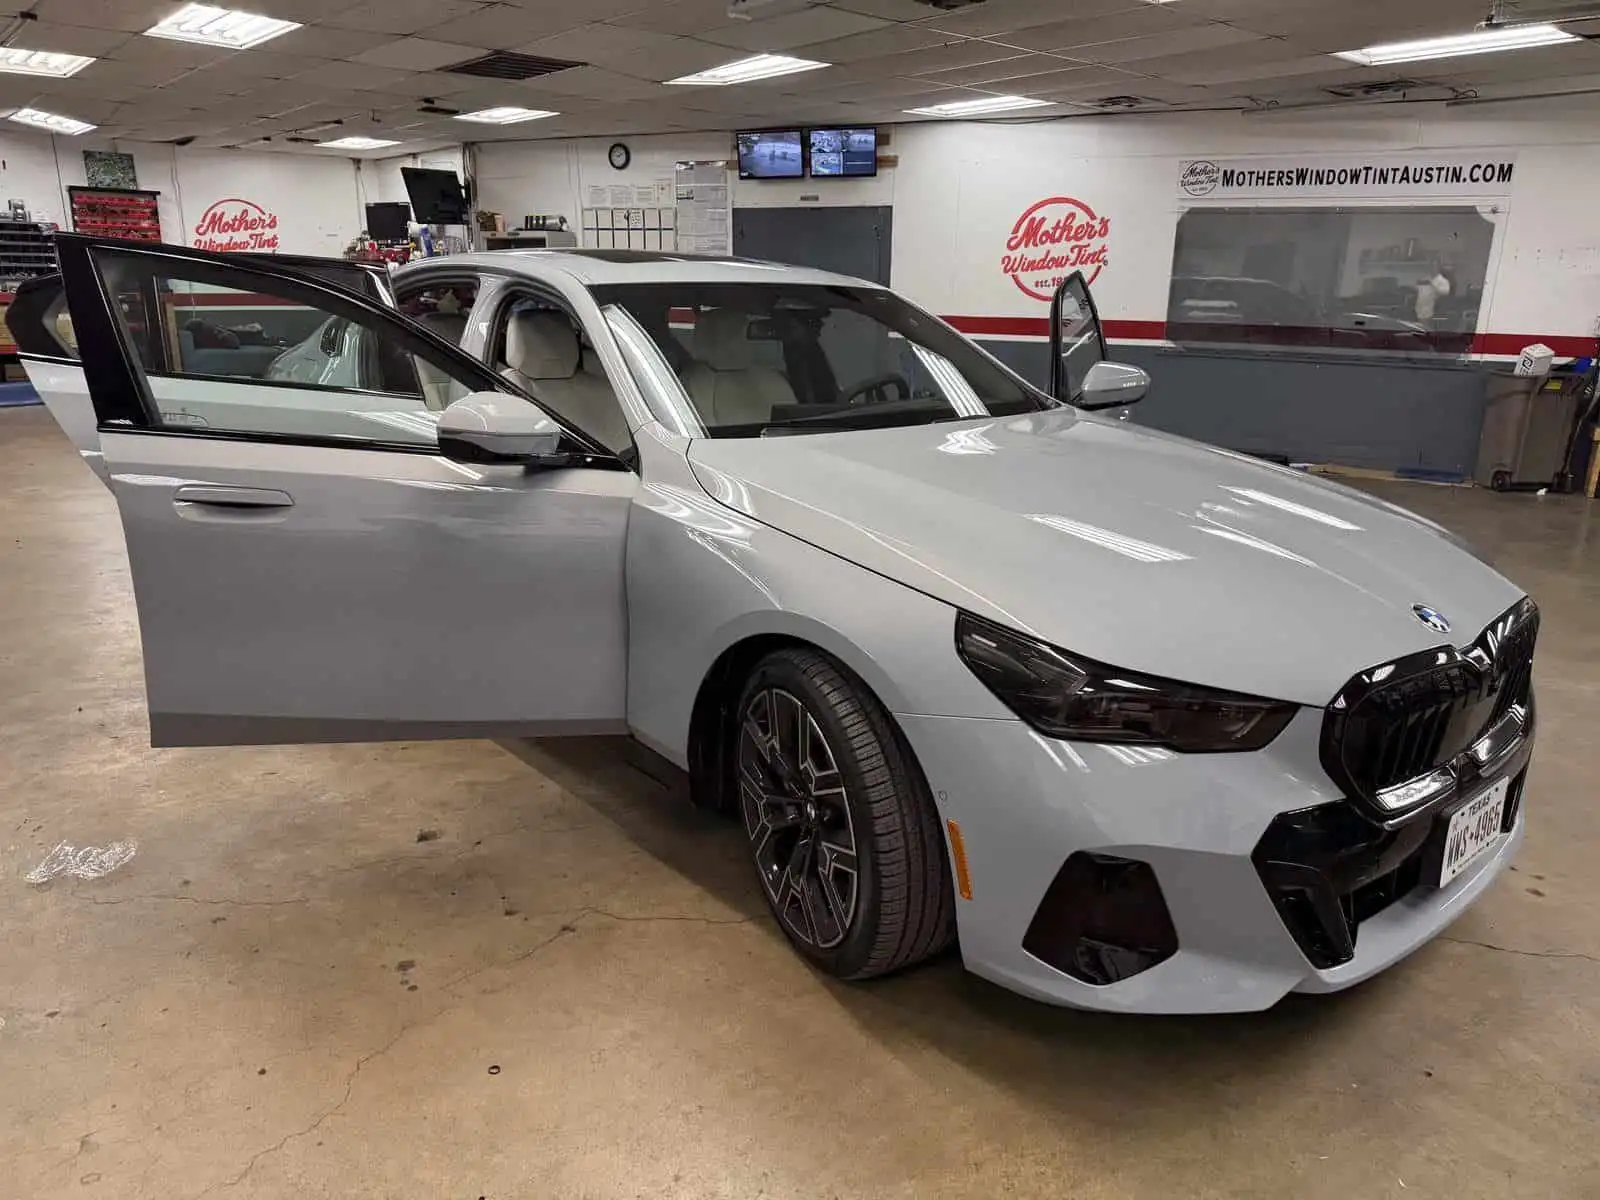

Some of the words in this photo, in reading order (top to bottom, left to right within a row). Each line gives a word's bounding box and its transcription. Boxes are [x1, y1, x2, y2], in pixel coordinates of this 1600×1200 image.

[195, 208, 277, 236] Mother's
[1006, 211, 1110, 251] Mother's
[249, 232, 279, 250] Tint
[1001, 249, 1070, 274] Window
[1069, 243, 1108, 267] Tint
[1468, 791, 1491, 816] TEXAS
